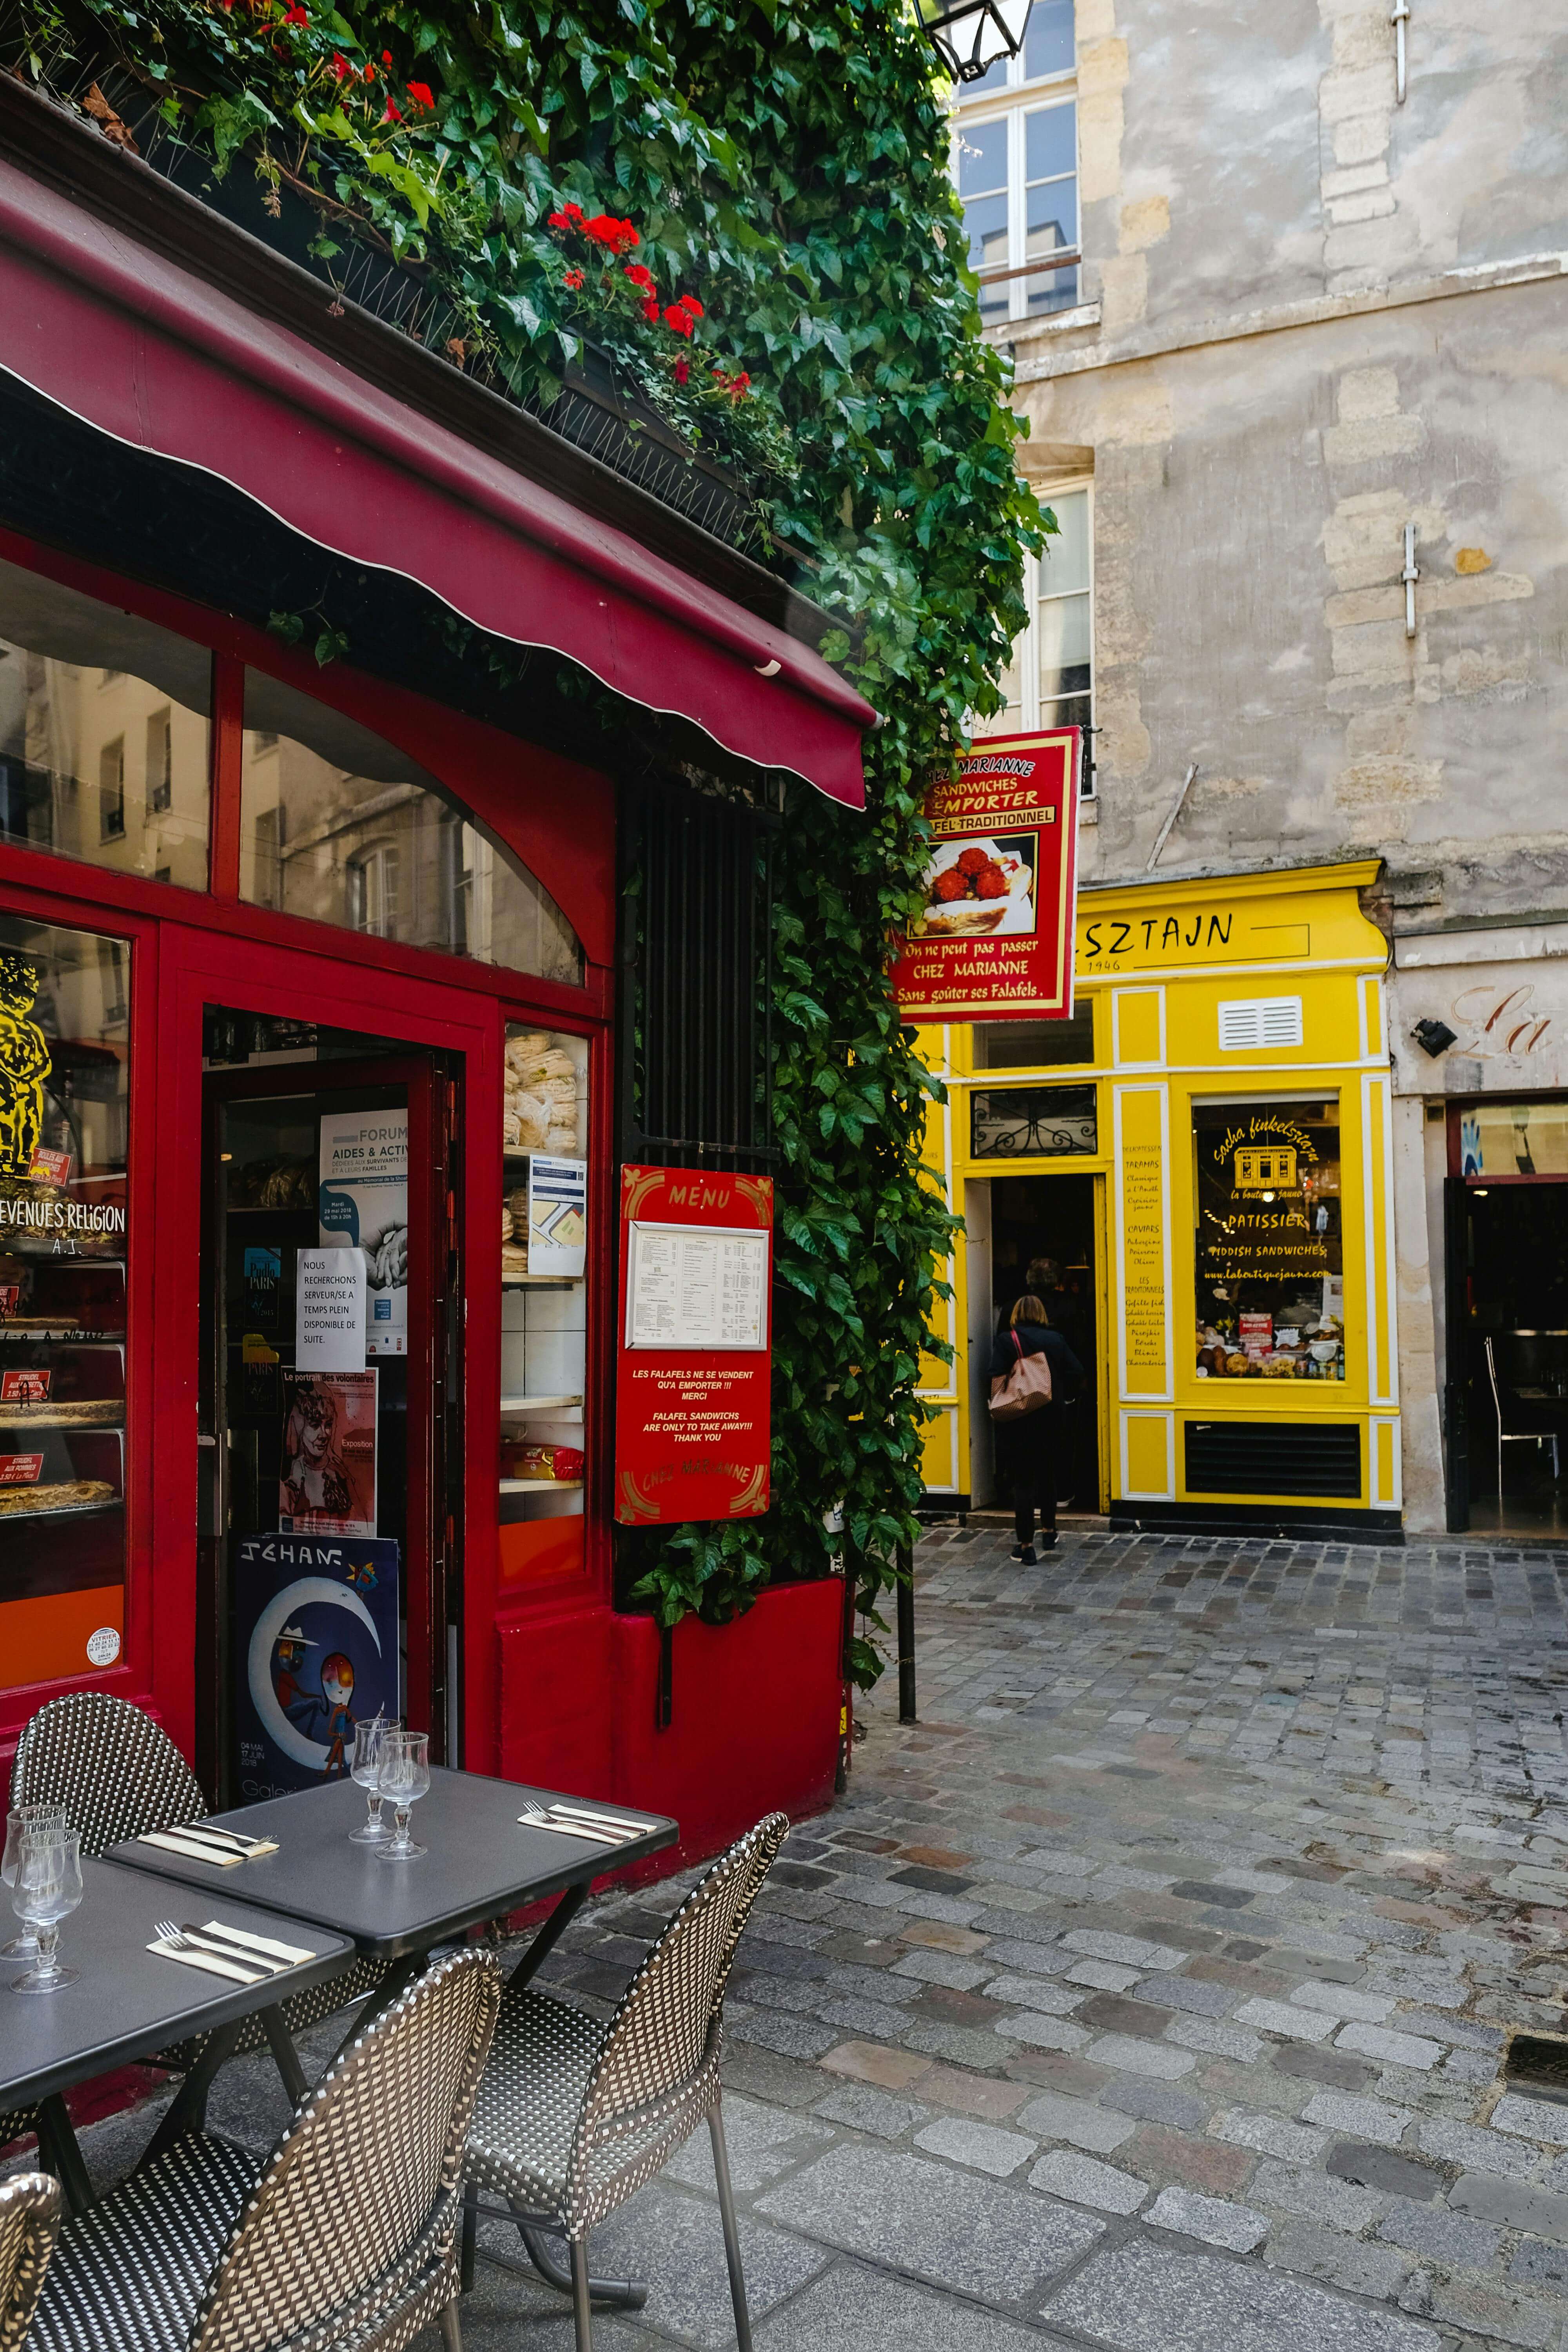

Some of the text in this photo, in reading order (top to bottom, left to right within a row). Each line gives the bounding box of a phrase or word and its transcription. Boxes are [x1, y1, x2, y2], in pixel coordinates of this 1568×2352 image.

[957, 757, 1036, 777] MARIANNE
[934, 778, 1018, 798] SANDWICHES
[960, 810, 1052, 829] TRADITIONNEL
[1076, 913, 1232, 957] SZTAJN
[905, 940, 1038, 960] On ne peut pas passer
[913, 960, 1029, 979] CHEZ MARIANNE
[1089, 960, 1120, 972] 1946
[898, 988, 926, 1002] Sans
[931, 986, 968, 1004] goûter
[971, 987, 988, 999] ses
[360, 1127, 408, 1142] FORUM
[332, 1148, 365, 1159] AIDES
[368, 1147, 375, 1156] &
[1126, 1160, 1159, 1169] TARAMAS
[669, 1185, 730, 1209] MENU
[1229, 1213, 1305, 1228] PATISSIER
[1128, 1225, 1160, 1233] CAVIARS
[1256, 1245, 1325, 1256] SANDWICHES
[250, 1277, 274, 1289] PARIS
[1139, 1276, 1149, 1285] LES
[305, 1290, 346, 1300] SERVEUR/SE
[285, 1372, 374, 1383] Le portrait des volontaires
[342, 1439, 373, 1448] Exposition
[674, 1434, 702, 1442] THANK
[92, 1633, 116, 1642] VITRIER
[241, 1758, 257, 1766] 2018
